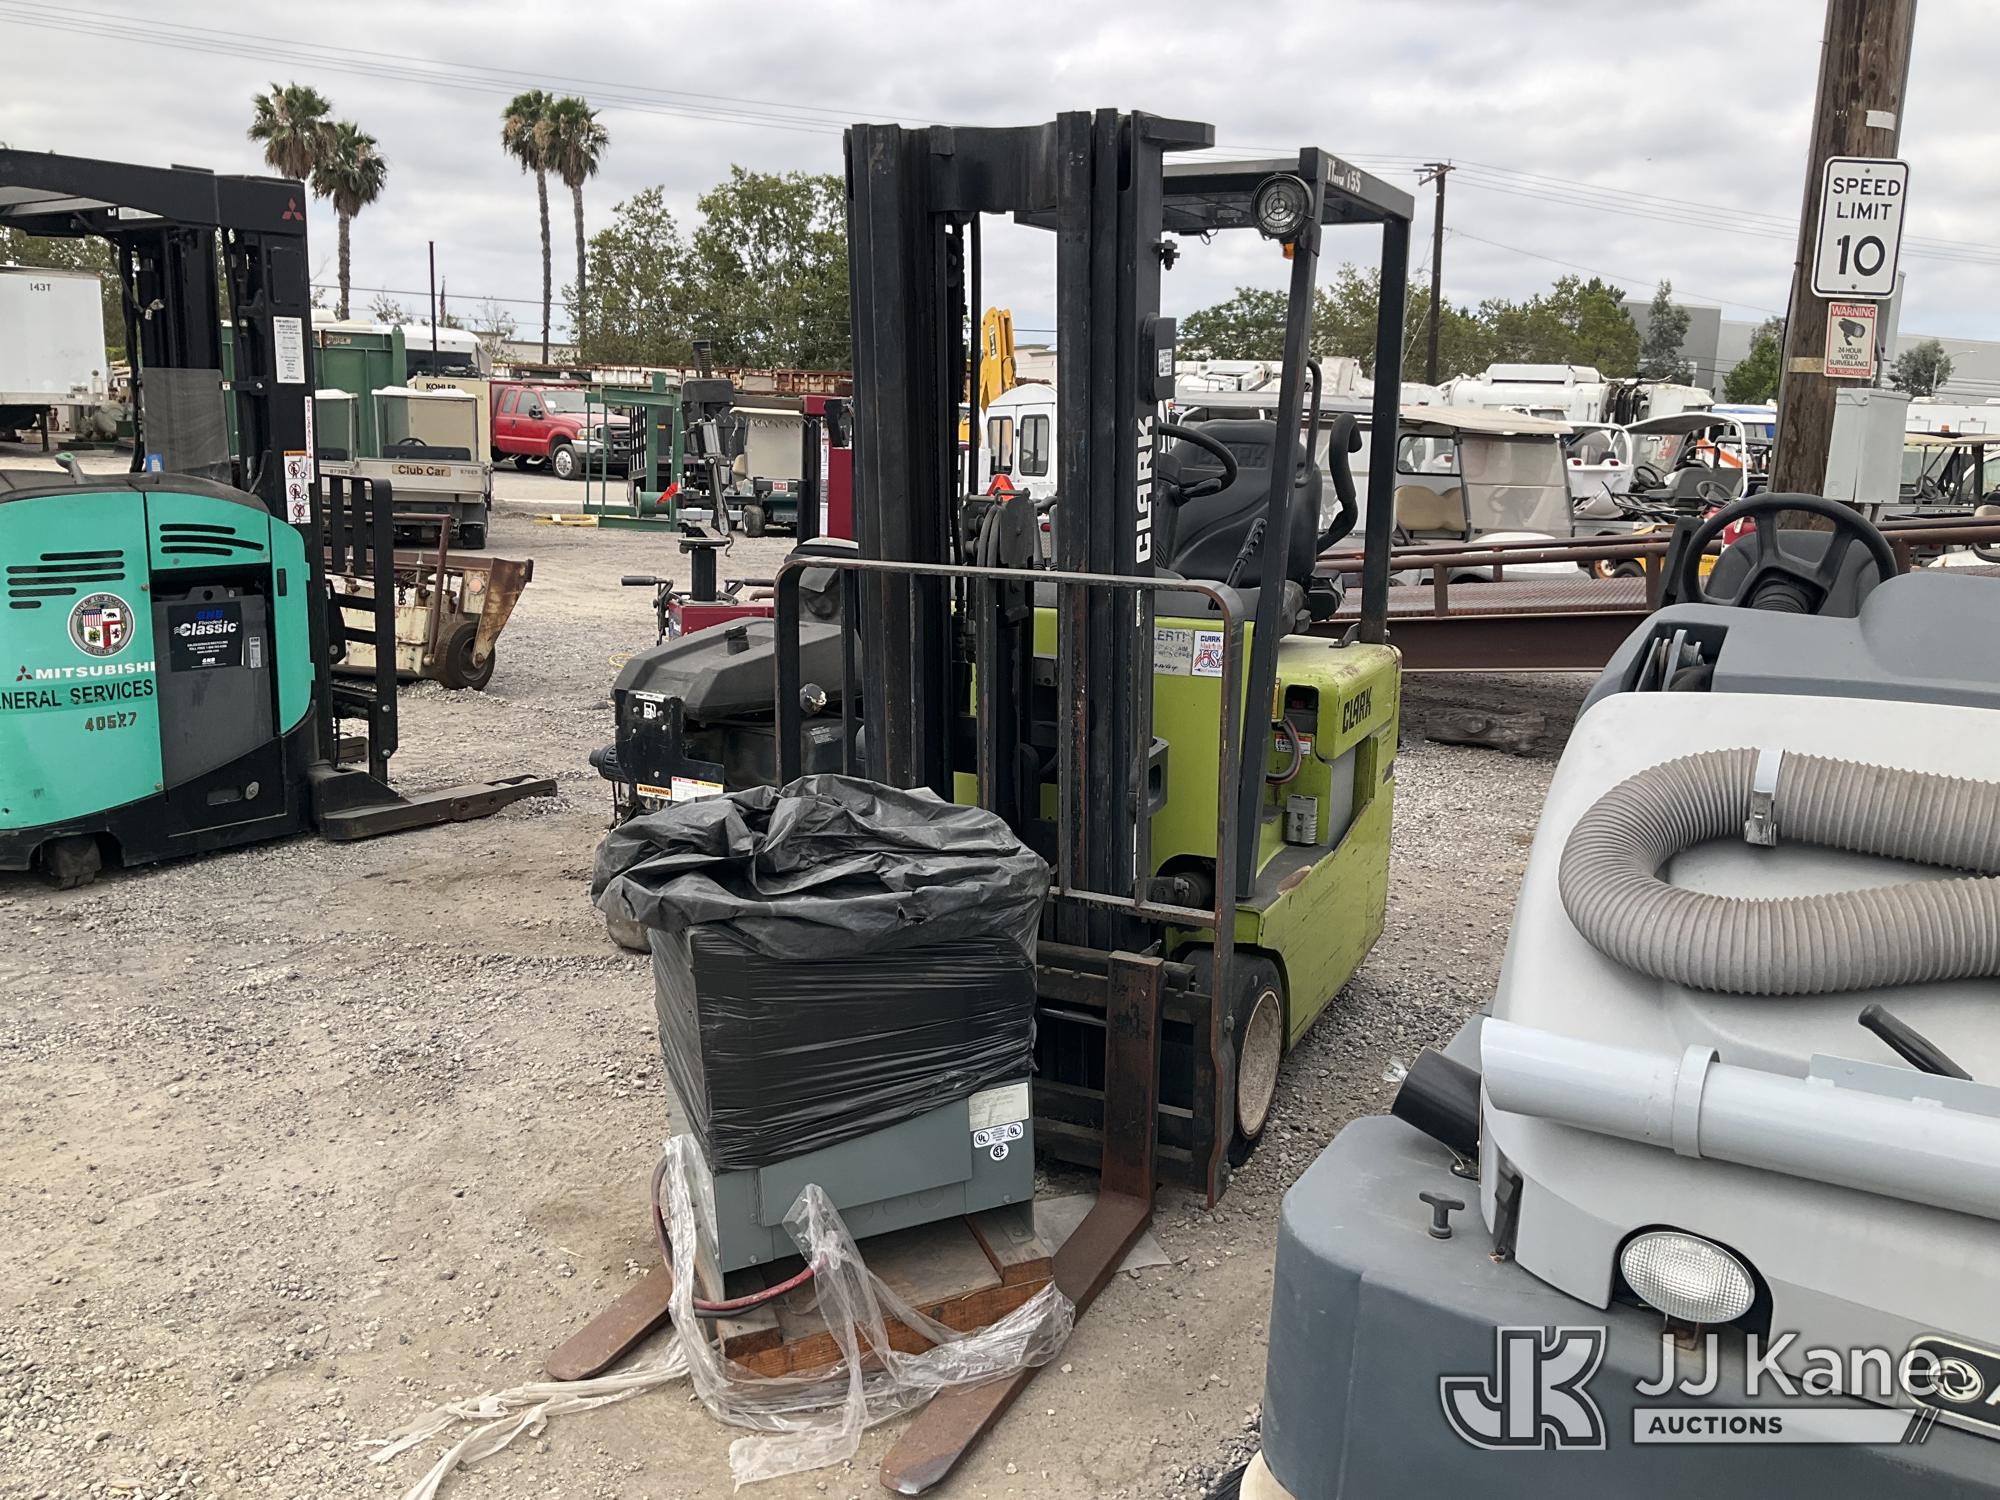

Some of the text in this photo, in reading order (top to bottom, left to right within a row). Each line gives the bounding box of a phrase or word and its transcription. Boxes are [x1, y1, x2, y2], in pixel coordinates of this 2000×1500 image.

[1832, 177, 1901, 196] SPEED
[1836, 201, 1893, 220] LIMIT
[1837, 235, 1886, 277] 10
[1832, 305, 1875, 318] WARNING
[1841, 353, 1859, 361] VIDEO
[398, 464, 445, 477] Club Car
[1136, 415, 1154, 564] CLARK
[179, 620, 237, 637] Classic
[1200, 635, 1221, 643] CLARK
[35, 661, 156, 680] MITSUBISHI
[0, 679, 154, 710] NERAL SERVICES
[1342, 686, 1373, 735] CLARK
